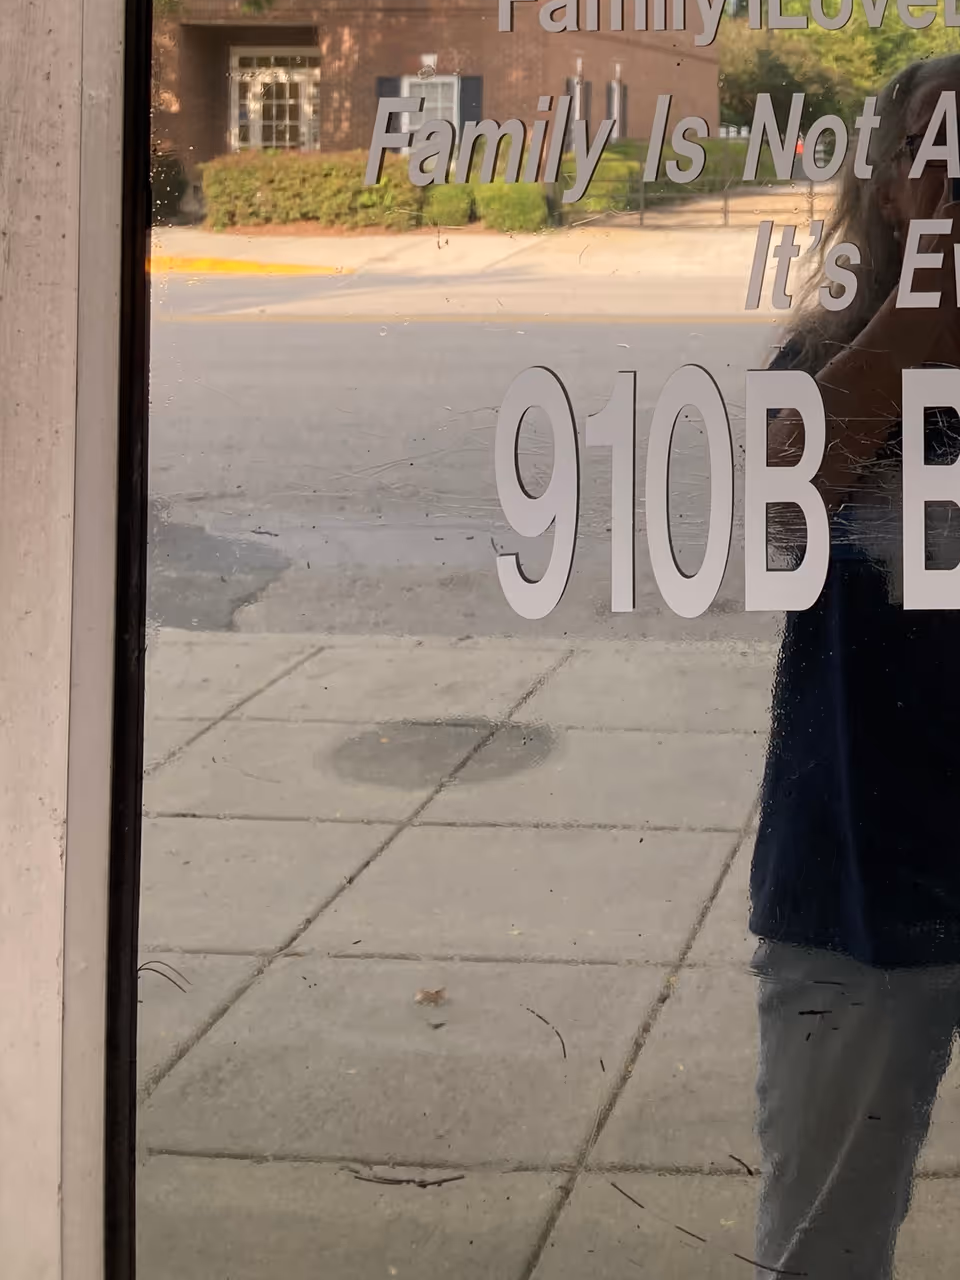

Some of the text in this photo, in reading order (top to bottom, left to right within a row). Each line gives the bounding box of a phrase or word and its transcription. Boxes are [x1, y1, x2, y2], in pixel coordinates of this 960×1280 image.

[364, 94, 616, 203] Family
[643, 94, 709, 184] Is
[742, 92, 881, 182] Not
[744, 220, 861, 311] It's
[494, 363, 830, 619] 910B
